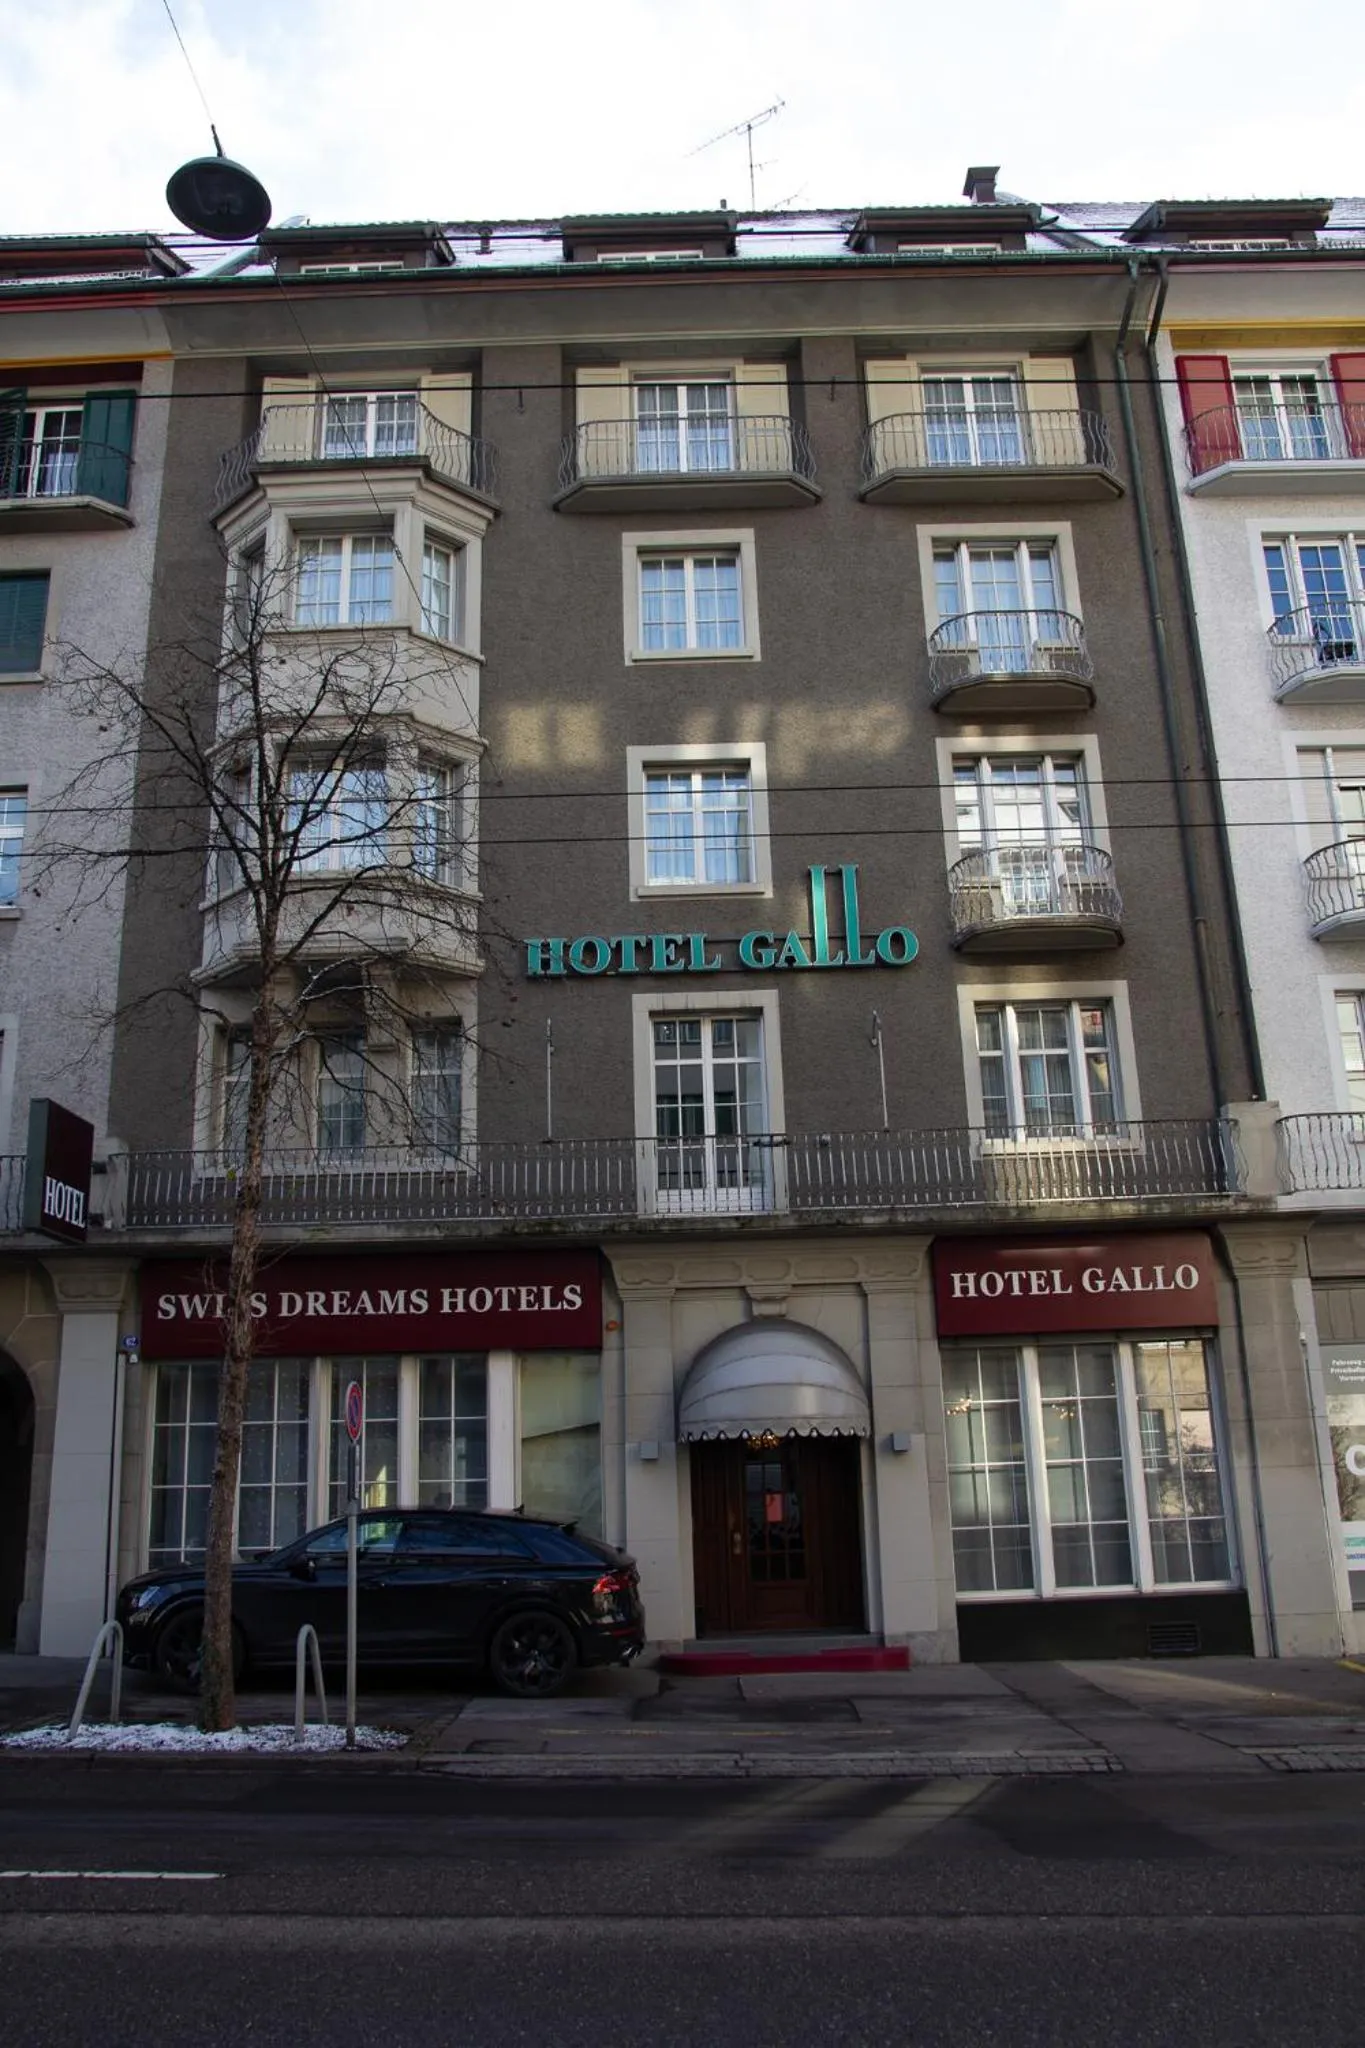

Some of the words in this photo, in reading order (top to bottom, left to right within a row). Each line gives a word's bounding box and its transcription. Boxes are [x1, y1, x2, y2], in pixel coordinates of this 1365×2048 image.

[527, 931, 722, 976] HOTEL
[739, 863, 920, 970] GALLO
[44, 1175, 86, 1228] HOTEL
[157, 1292, 268, 1320] SWIS
[278, 1288, 430, 1318] DREAMS
[439, 1283, 583, 1314] HOTELS
[950, 1269, 1073, 1298] HOTEL
[1081, 1263, 1200, 1294] GALLO
